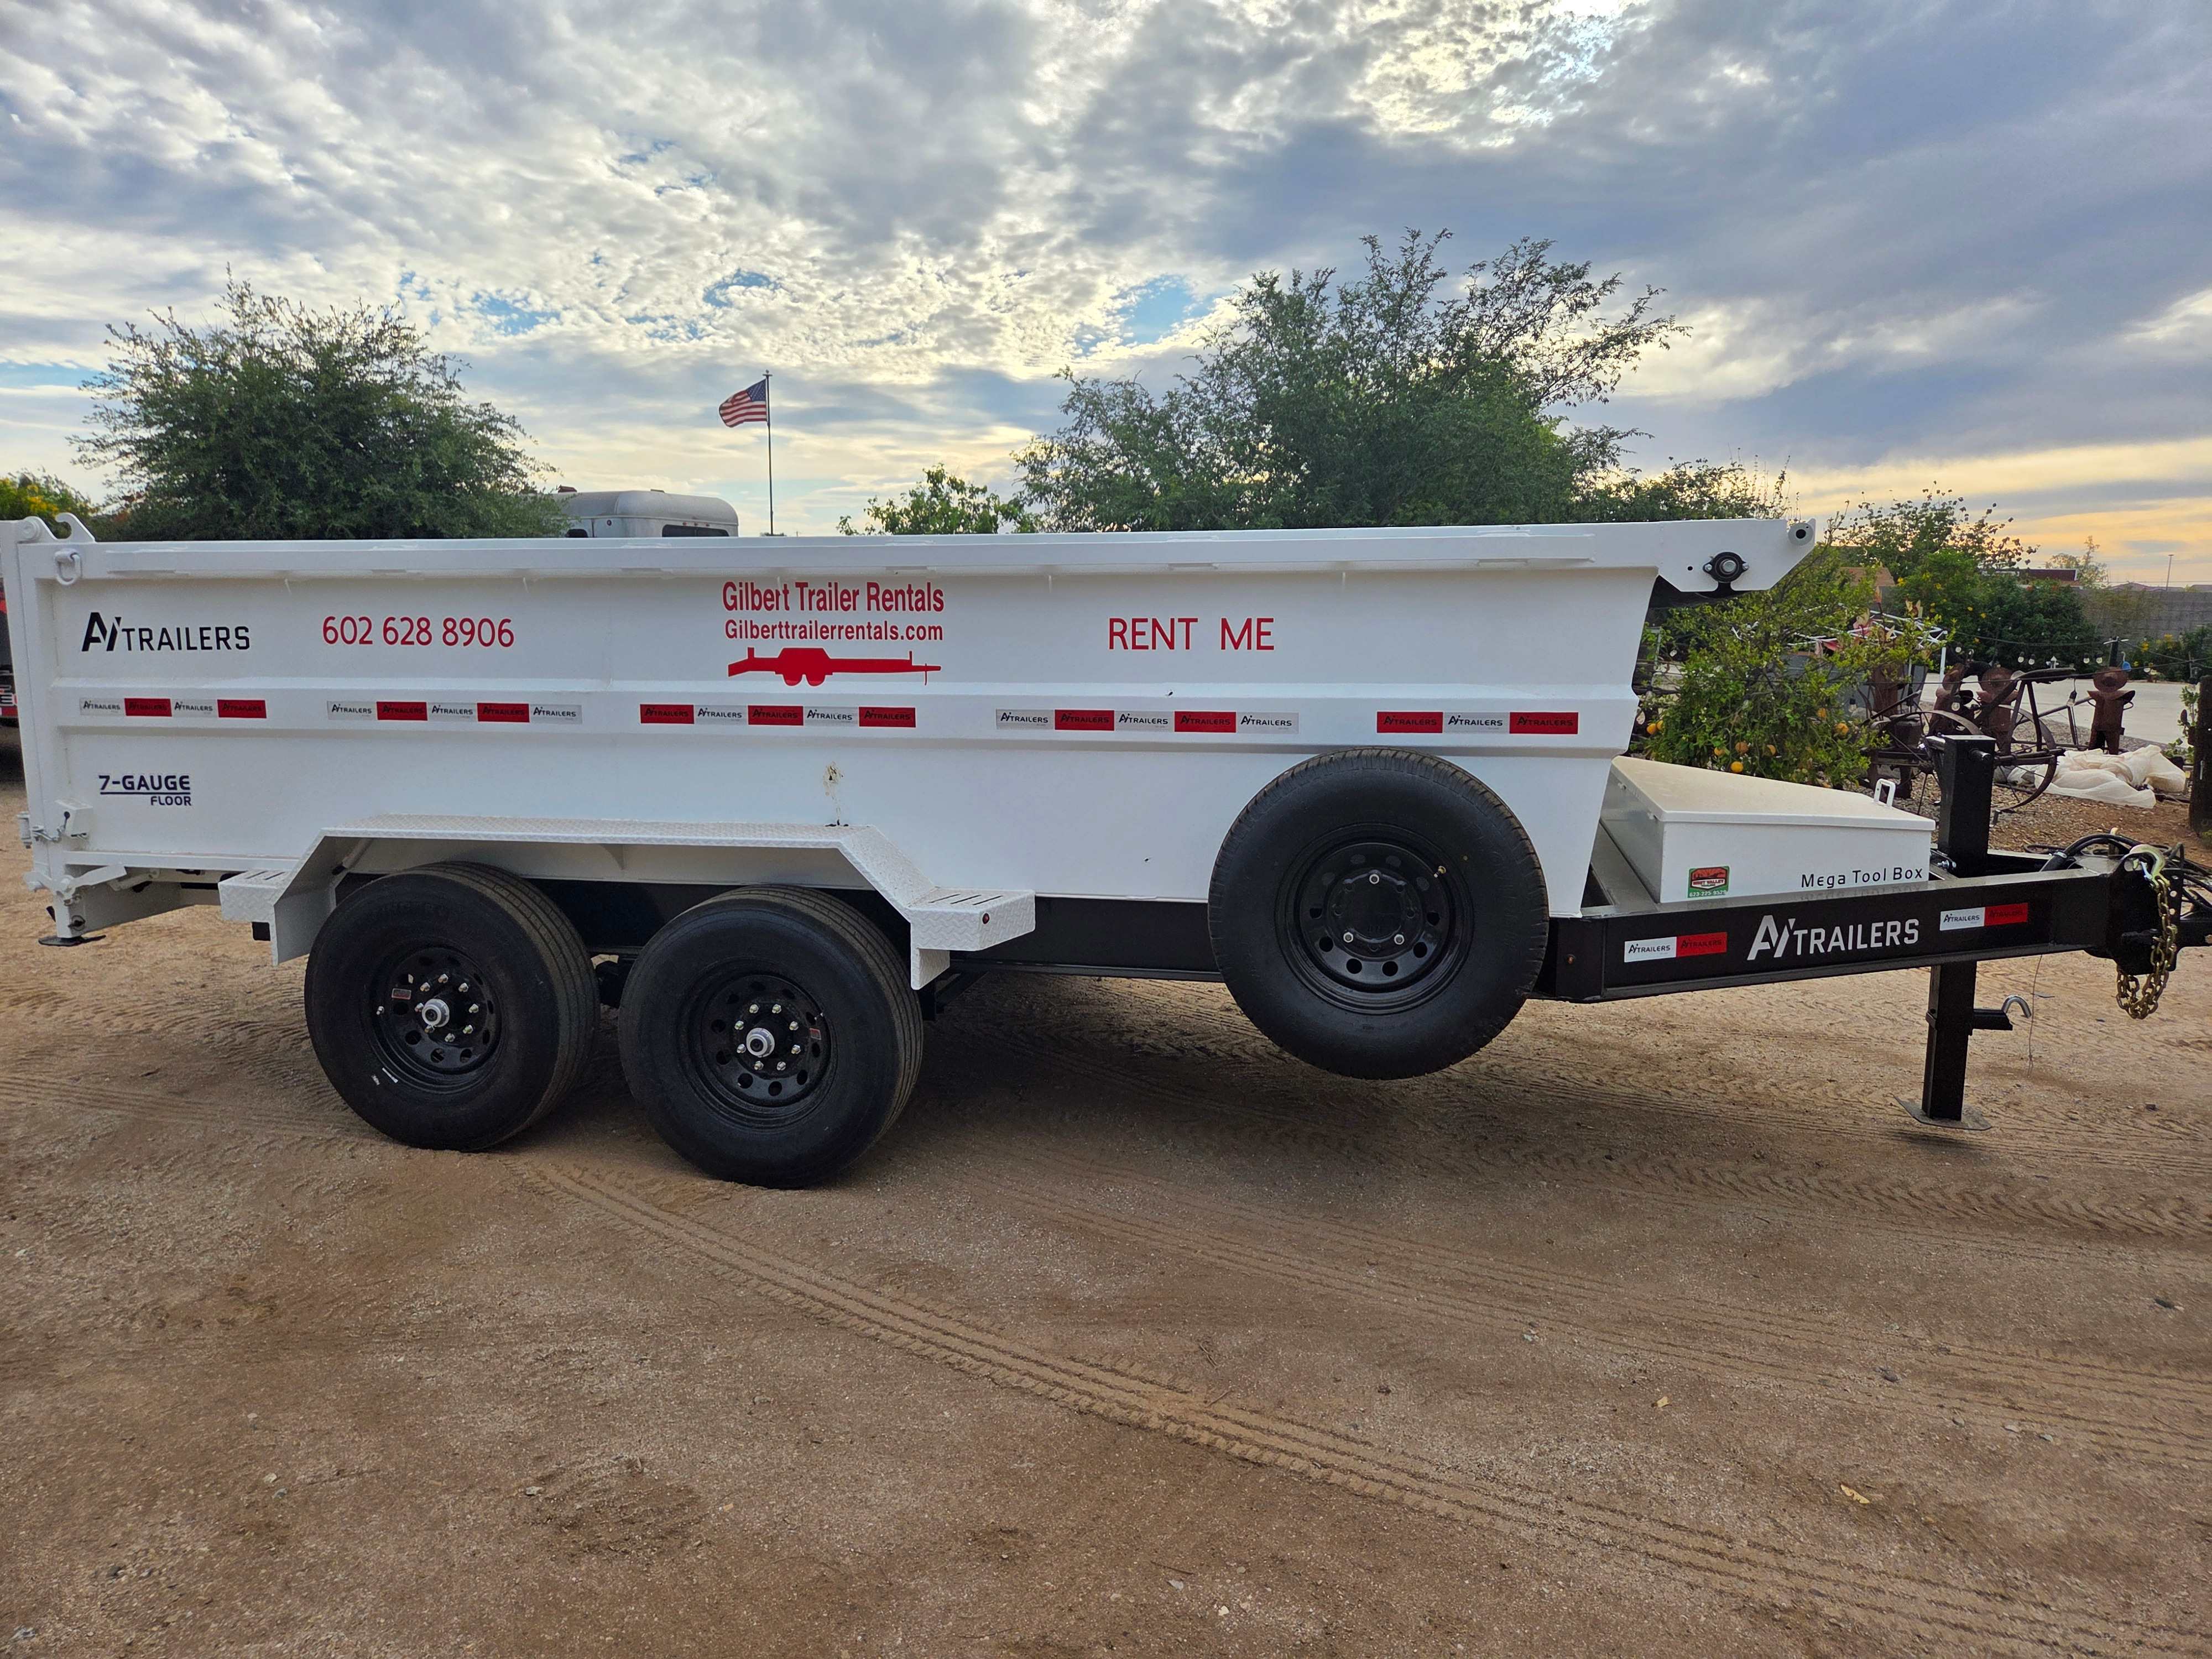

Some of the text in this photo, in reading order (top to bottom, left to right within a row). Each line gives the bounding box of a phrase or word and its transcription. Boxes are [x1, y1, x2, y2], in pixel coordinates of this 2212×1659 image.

[723, 581, 945, 612] Gilbert Trailer Rentals
[122, 626, 250, 651] TRAILERS
[323, 616, 514, 648] 602 628 8906
[725, 619, 943, 640] Gilberttrailerrentals.com
[1109, 618, 1274, 650] RENT ME
[98, 775, 190, 790] 7-GAUGE
[150, 796, 191, 806] FLOOR
[1801, 867, 1923, 888] Mega Tool Box
[1793, 919, 1919, 955] TRAILERS
